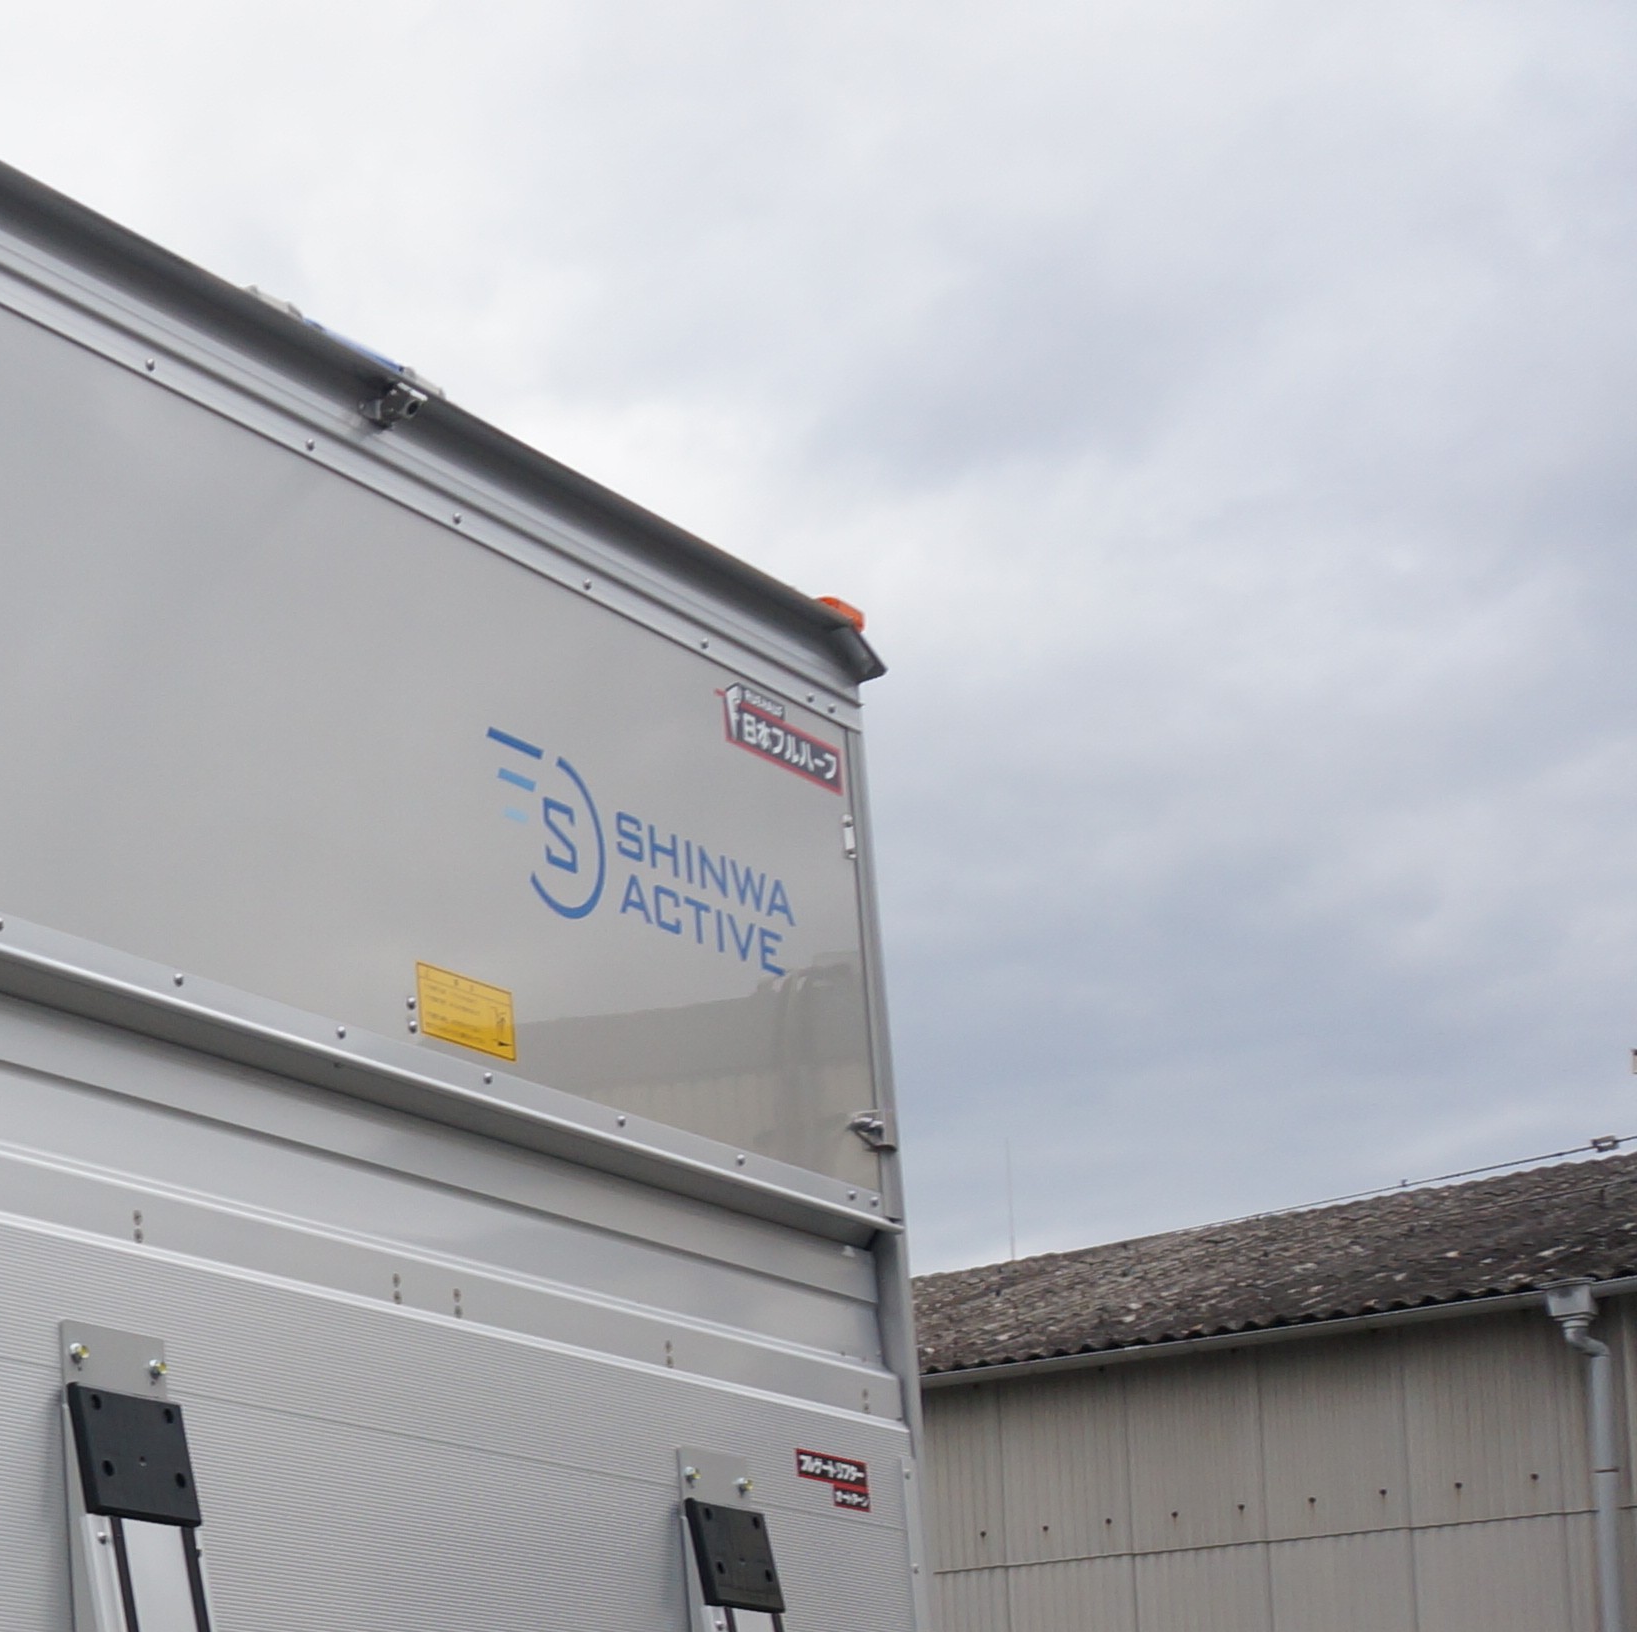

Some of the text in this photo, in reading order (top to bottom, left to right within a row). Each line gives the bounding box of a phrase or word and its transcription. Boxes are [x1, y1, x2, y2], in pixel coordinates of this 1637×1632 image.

[743, 713, 837, 780] 日本フルハーフ
[615, 811, 796, 926] SHINWA
[620, 874, 785, 976] ACTIVE
